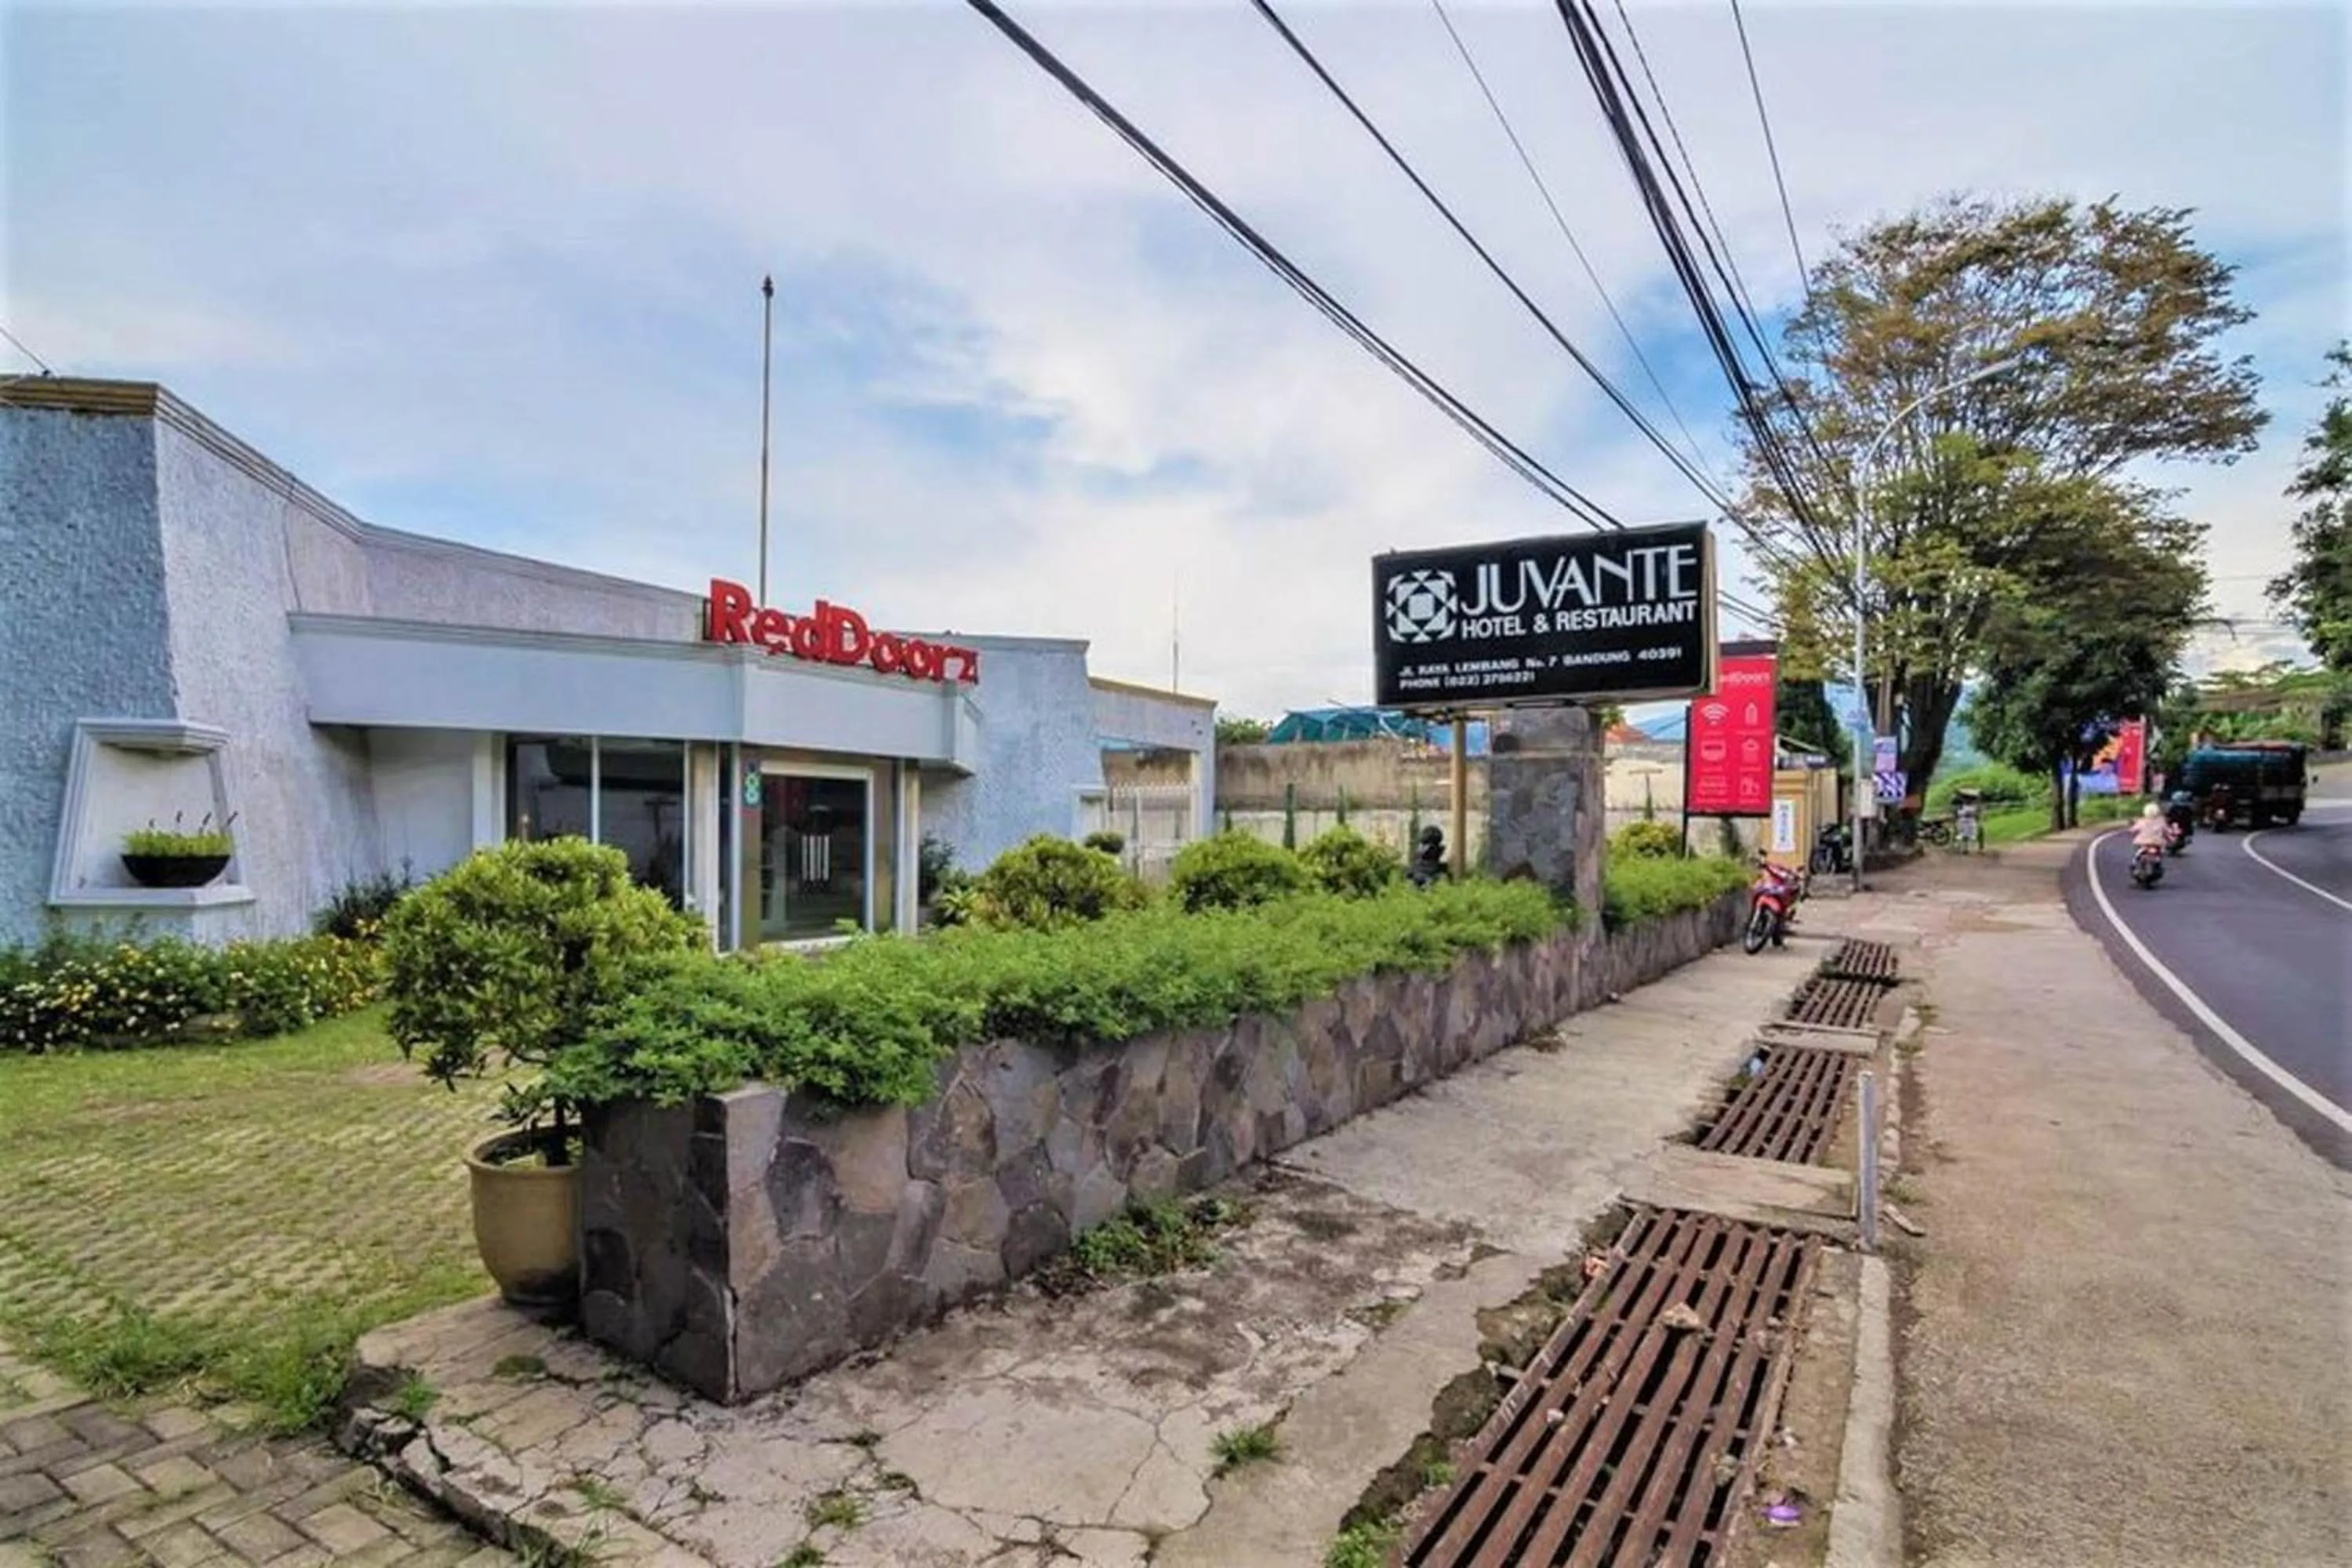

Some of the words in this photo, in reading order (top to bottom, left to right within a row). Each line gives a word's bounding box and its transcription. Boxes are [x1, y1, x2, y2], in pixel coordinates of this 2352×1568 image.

[1460, 543, 1697, 615] JUVANTE
[710, 579, 978, 684] RedDoorz
[1461, 615, 1526, 640] HOTEL
[1533, 612, 1550, 633] &
[1555, 600, 1697, 632] RESTAURANT
[1454, 658, 1519, 674] LEMBANG
[1563, 649, 1631, 666] BANDUNG
[1637, 646, 1682, 660] 40391
[1399, 677, 1440, 690] PHONE
